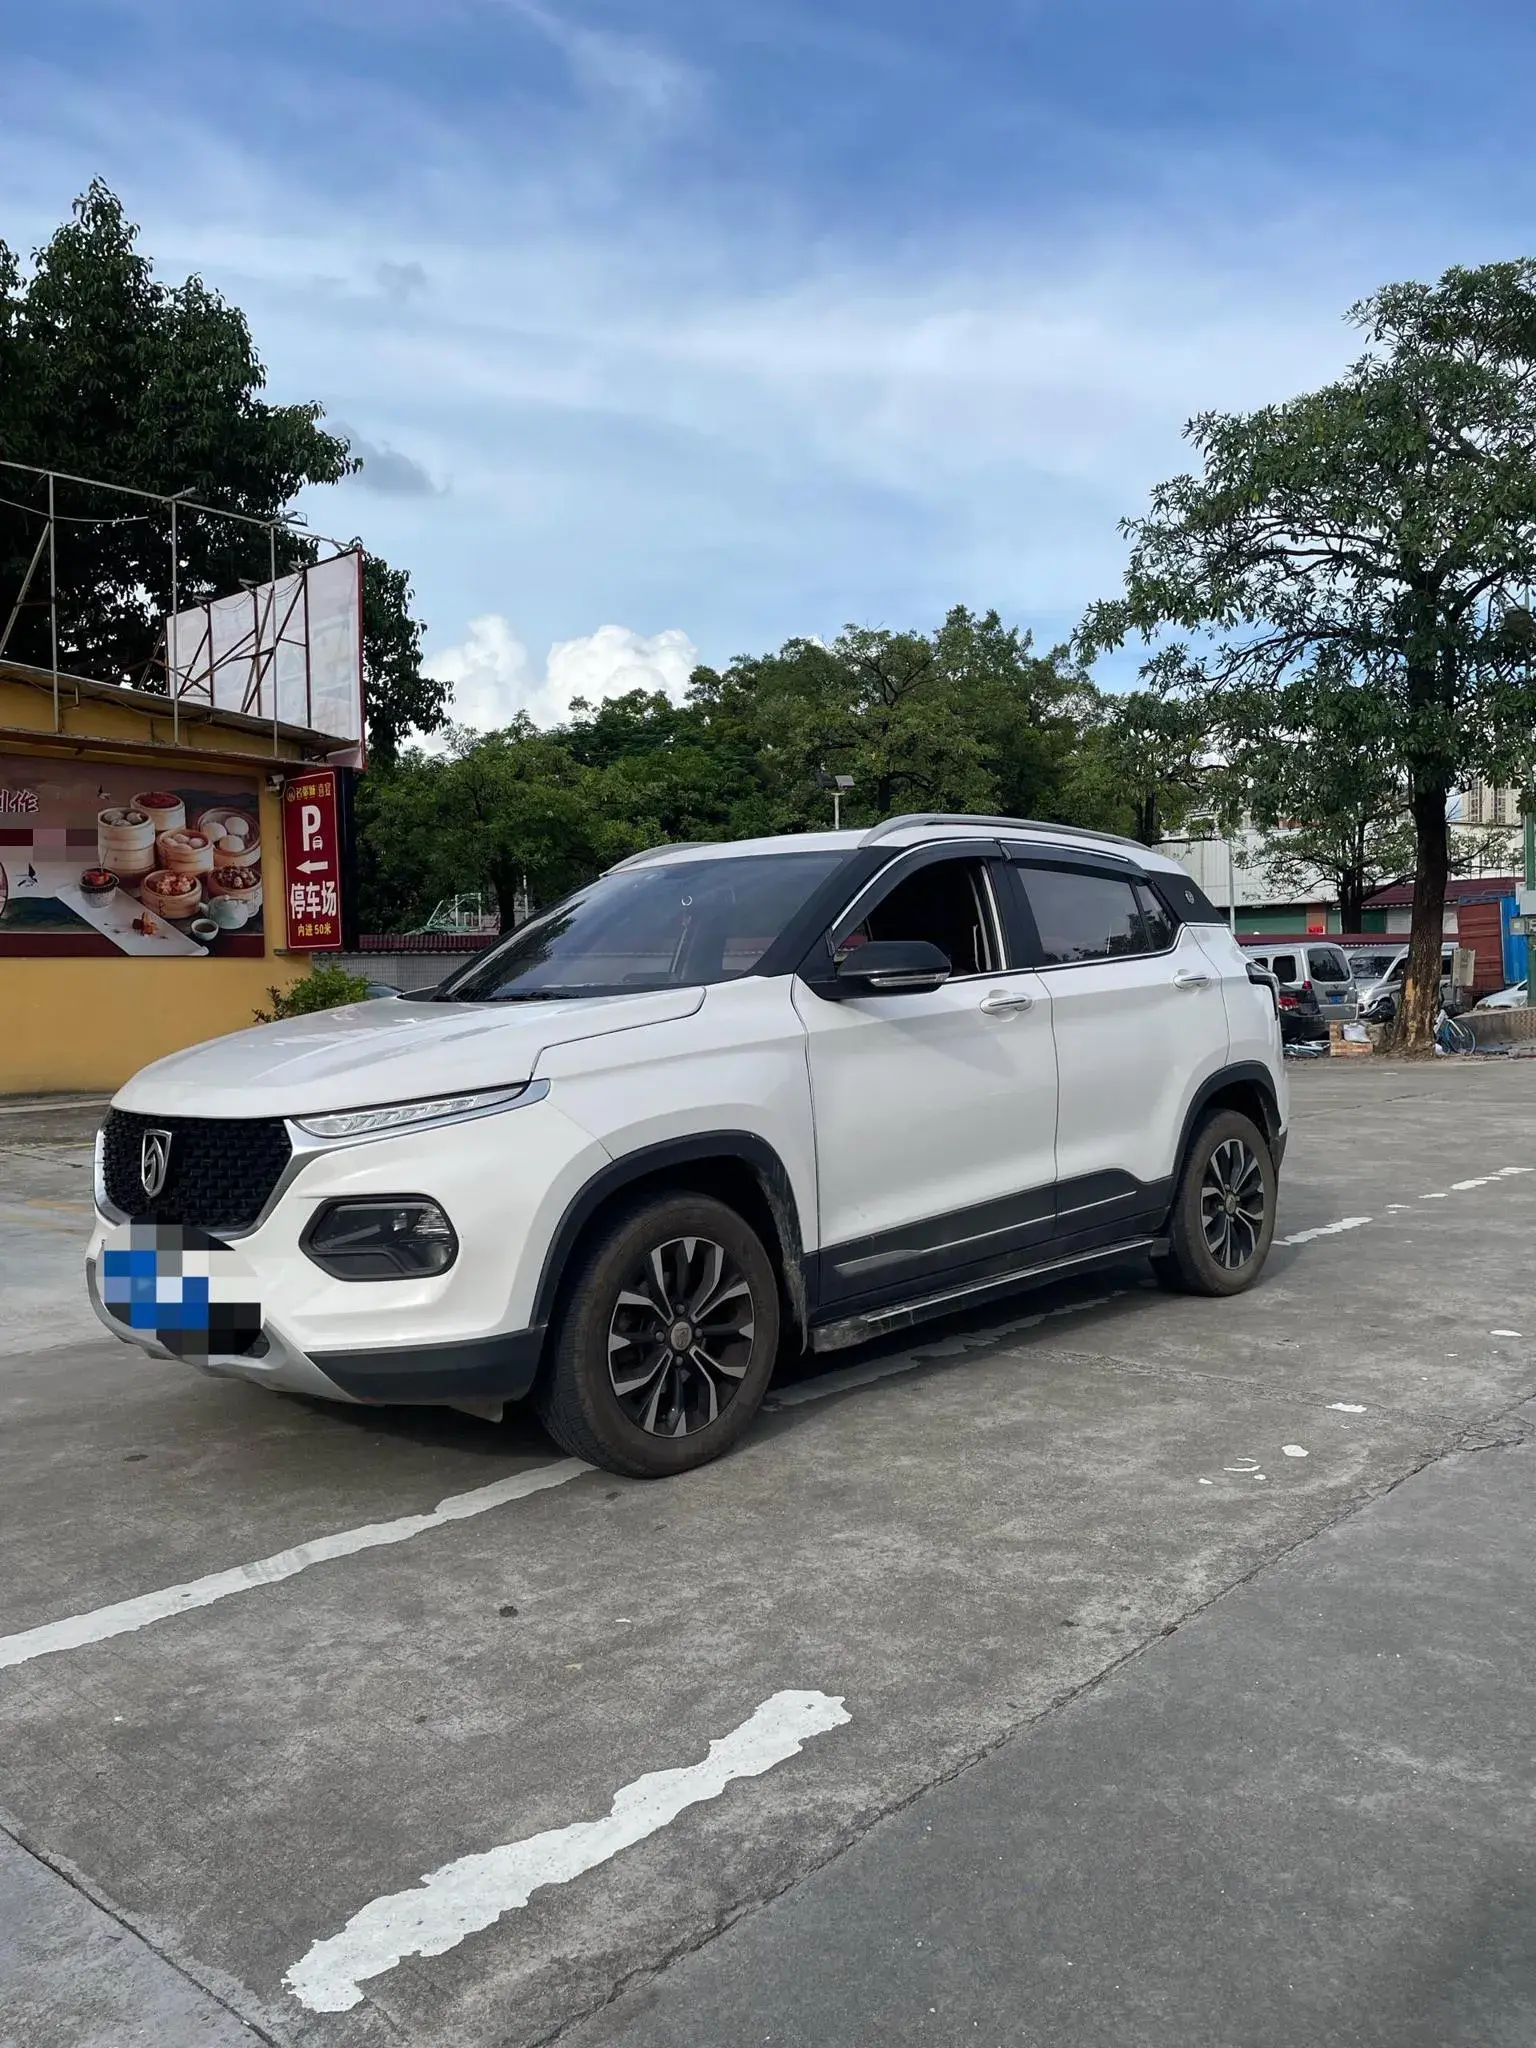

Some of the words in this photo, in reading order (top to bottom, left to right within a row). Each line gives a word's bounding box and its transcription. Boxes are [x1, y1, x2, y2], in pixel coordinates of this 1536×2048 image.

[302, 805, 321, 851] P
[290, 880, 336, 919] 停车场
